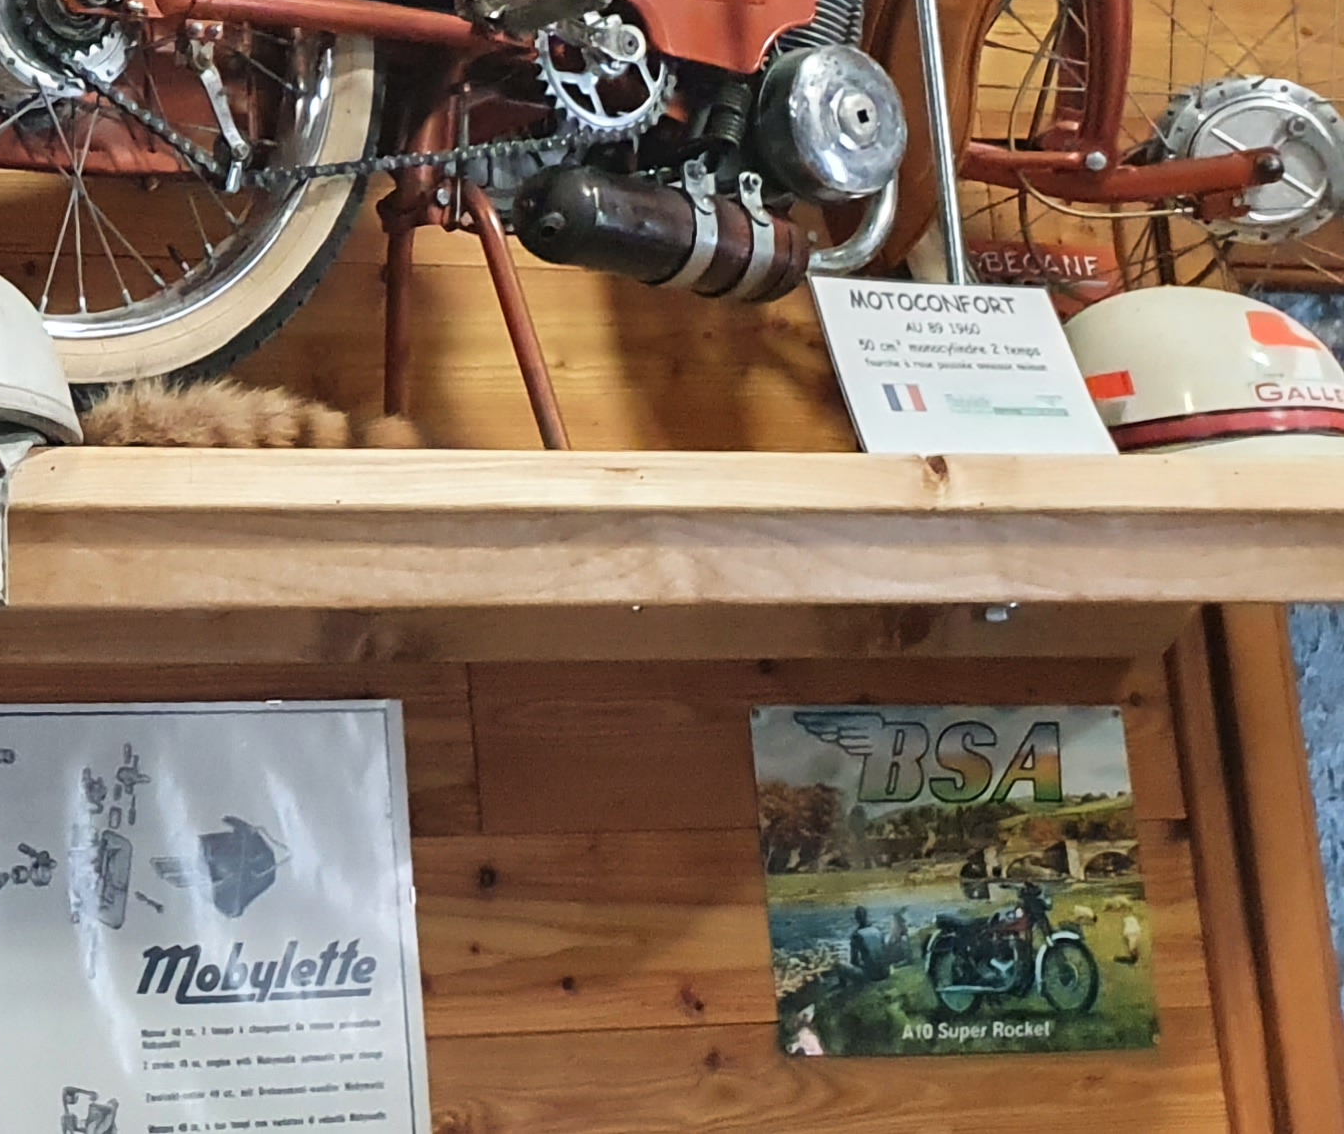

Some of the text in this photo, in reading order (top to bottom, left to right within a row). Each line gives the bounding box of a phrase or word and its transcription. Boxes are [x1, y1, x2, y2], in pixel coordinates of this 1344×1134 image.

[850, 289, 1016, 314] MOTOCONFORT
[905, 322, 923, 334] AU
[948, 322, 982, 336] 1960
[908, 341, 987, 357] monocylindre
[991, 343, 1001, 356] 2
[1004, 344, 1042, 358] temps
[859, 721, 1063, 803] BSA
[137, 939, 377, 1004] Mobylette
[901, 1020, 1051, 1042] A10 Super Rocket
